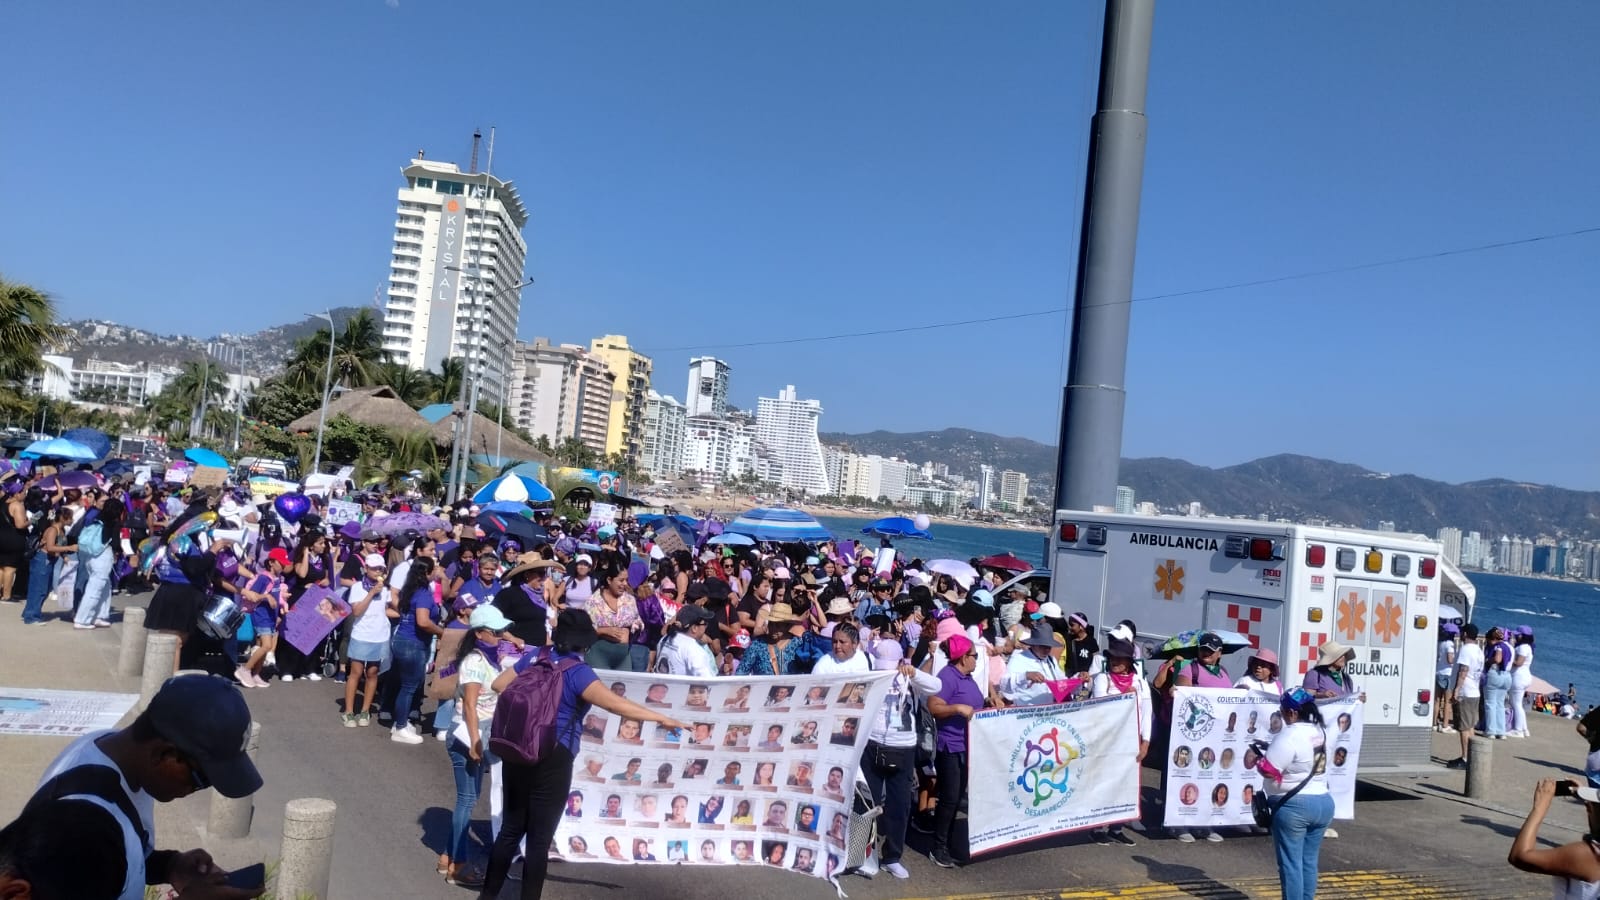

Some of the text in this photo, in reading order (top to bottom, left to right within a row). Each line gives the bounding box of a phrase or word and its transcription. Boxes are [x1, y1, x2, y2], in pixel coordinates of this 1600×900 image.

[439, 215, 456, 300] KRYSTAL
[1129, 532, 1219, 552] AMBULANCIA
[1343, 662, 1400, 677] BULANCIA
[975, 709, 999, 719] FAMILIAS
[1032, 716, 1067, 729] ACAPULCO
[1023, 725, 1032, 737] DE
[1009, 736, 1025, 773] FAMILIAS
[1024, 786, 1076, 817] DESAPARECIDOS
